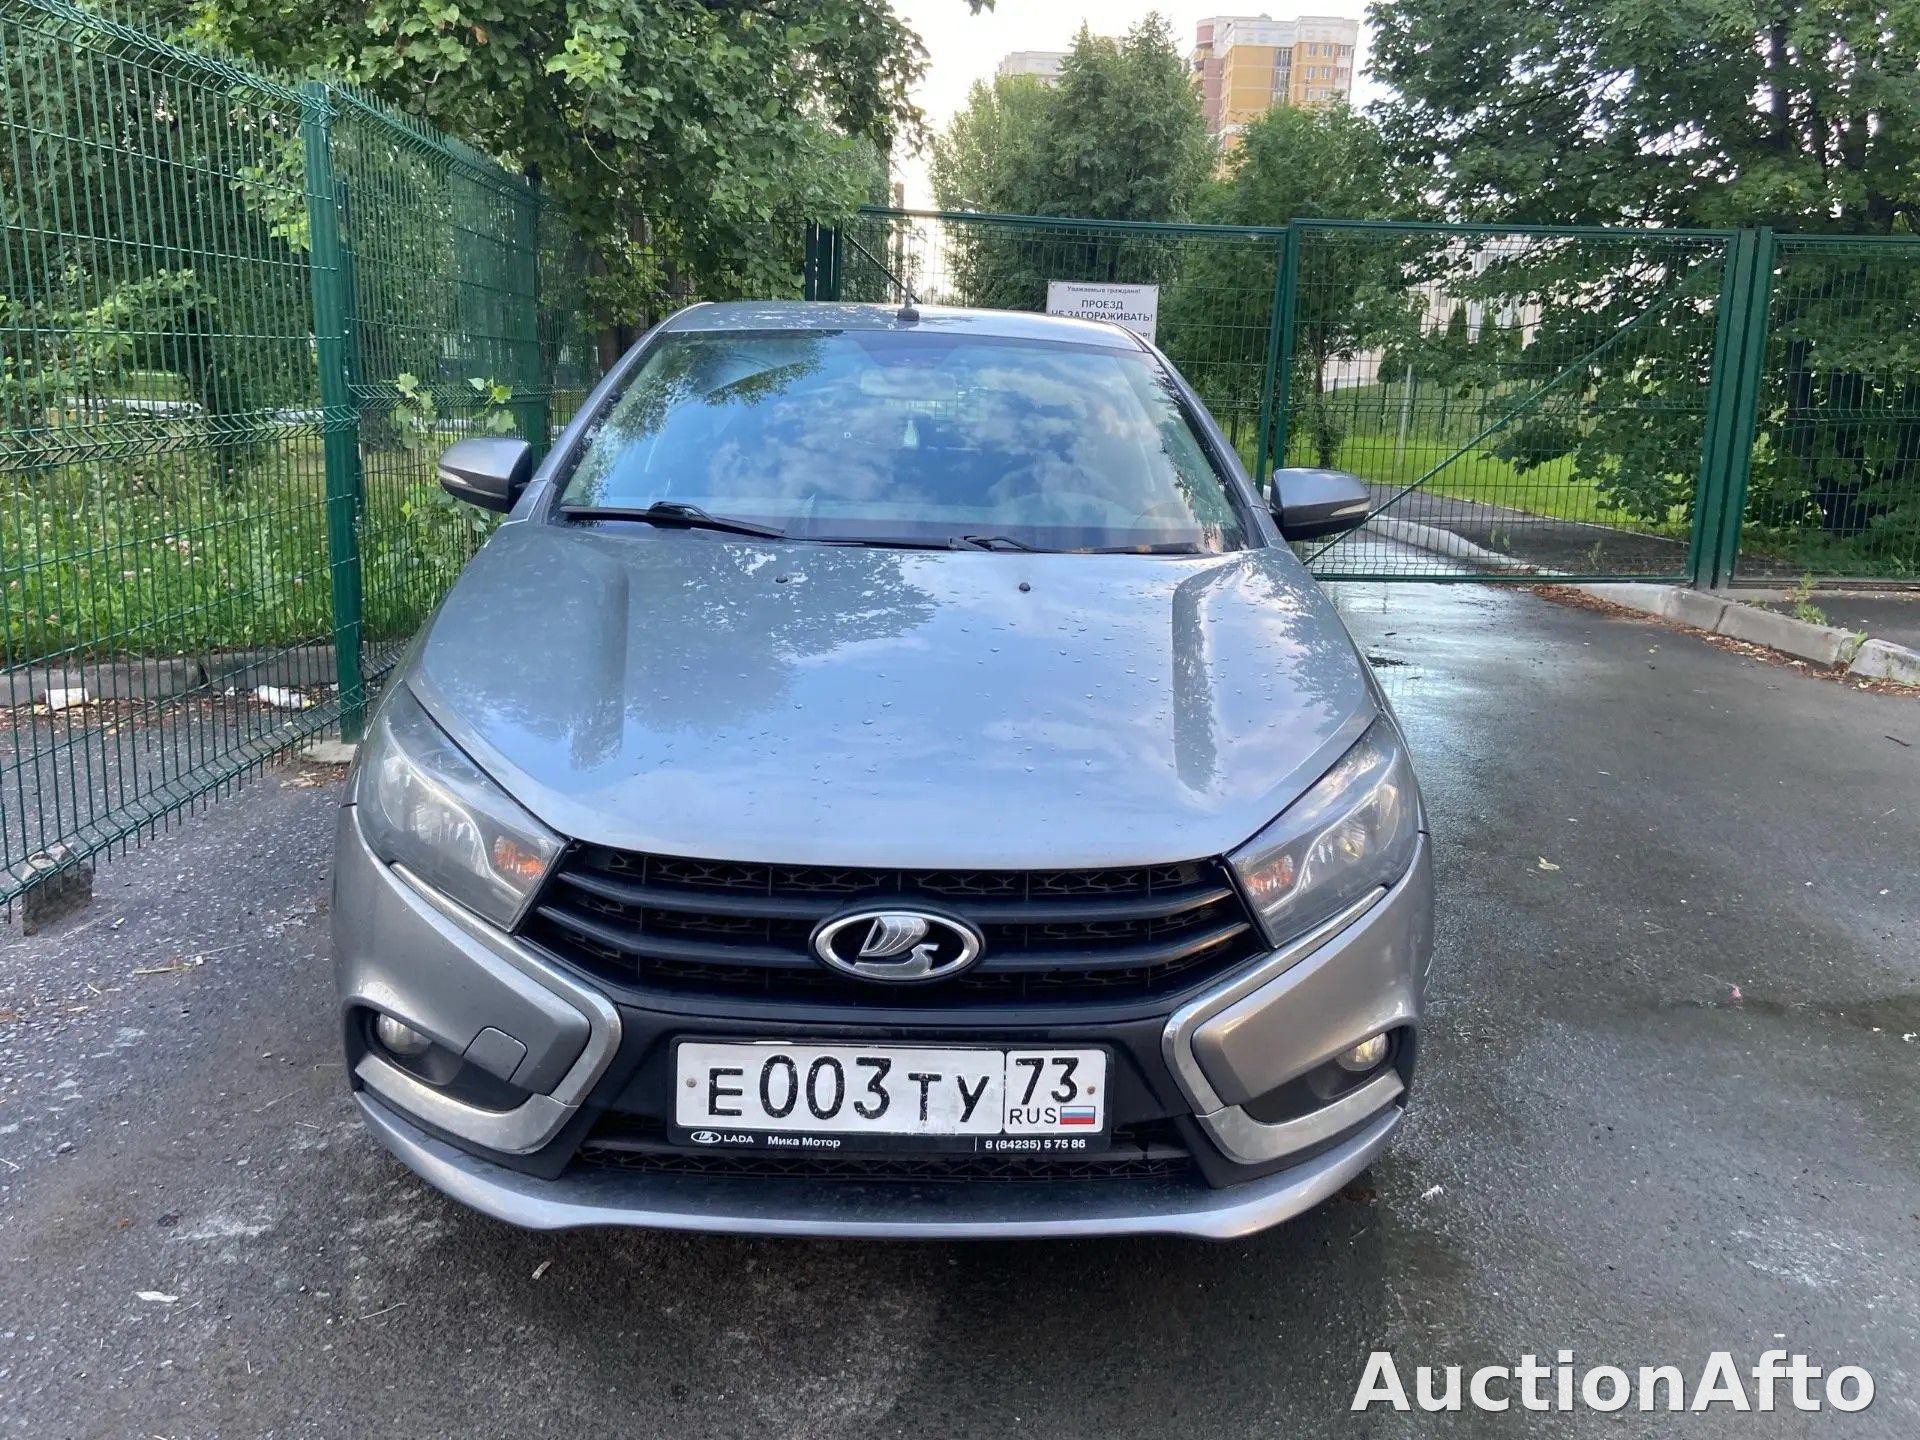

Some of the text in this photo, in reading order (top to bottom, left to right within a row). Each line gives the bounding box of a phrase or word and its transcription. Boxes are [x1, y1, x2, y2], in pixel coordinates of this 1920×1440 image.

[1081, 299, 1124, 310] ПРОЕЗД
[1068, 310, 1153, 322] ЗАГОРАЖИВАТЬ!
[1014, 1056, 1080, 1106] 73
[1008, 1105, 1058, 1126] RUS
[723, 1134, 754, 1144] LADA
[767, 1136, 841, 1149] Мика Мотор
[995, 1140, 1041, 1151] (84235)
[1054, 1140, 1069, 1149] 75
[1071, 1139, 1086, 1149] 86
